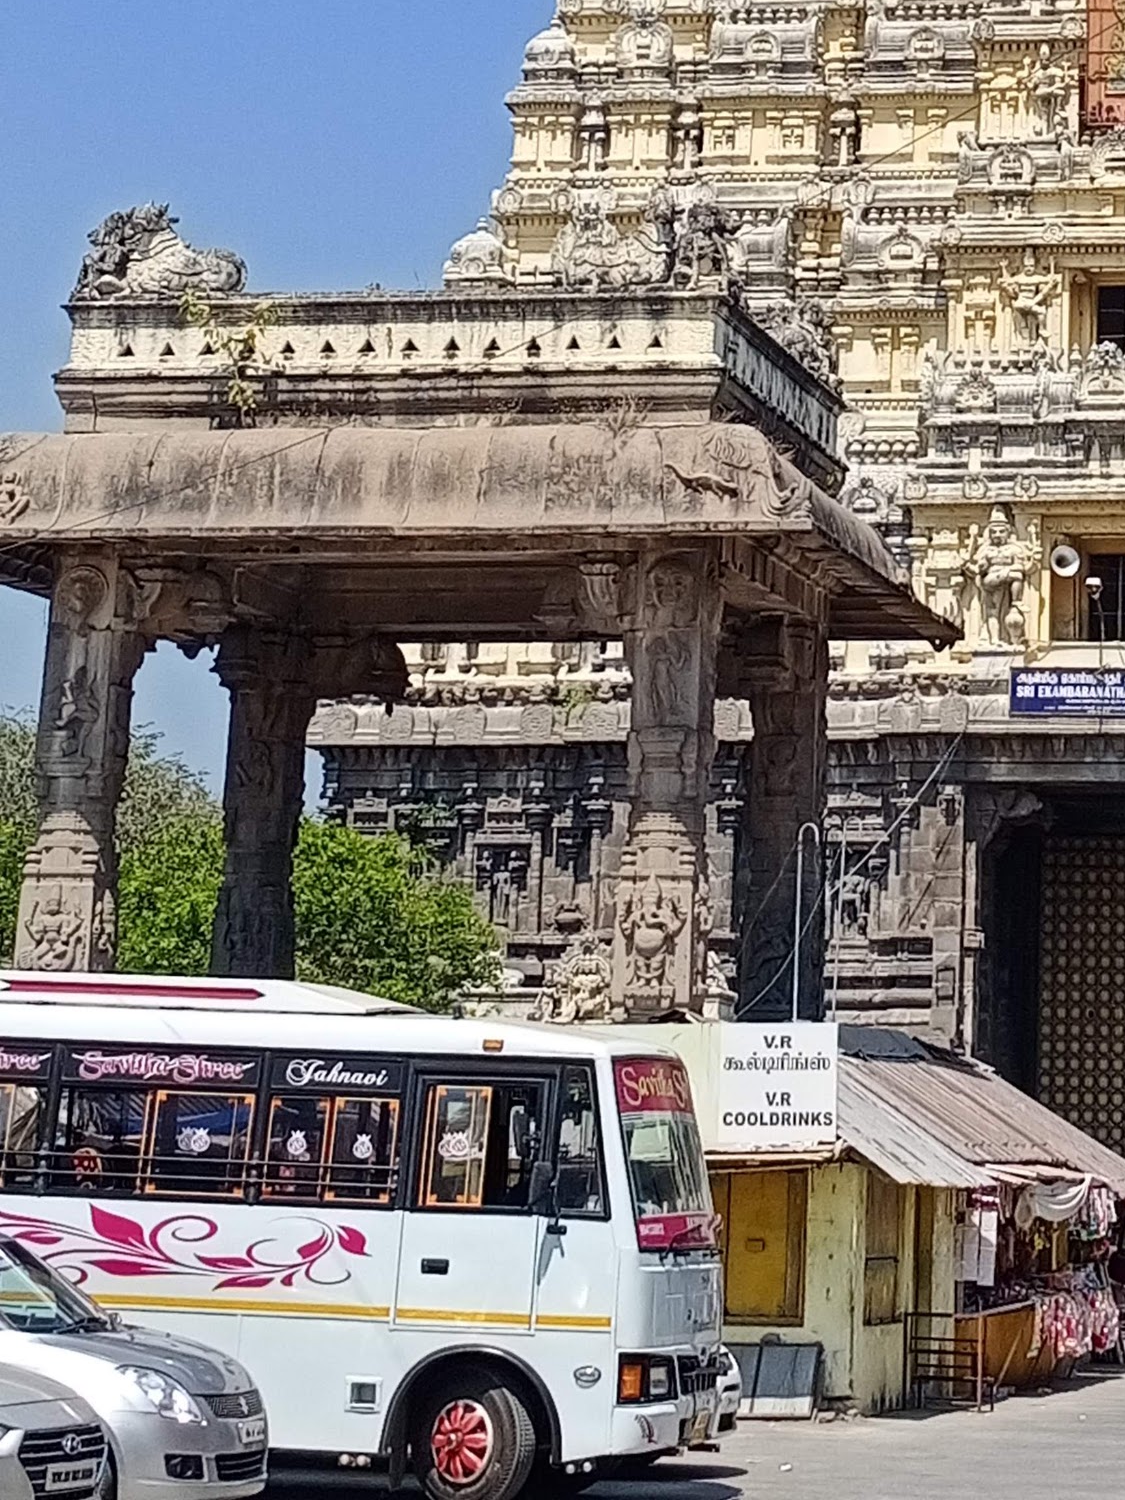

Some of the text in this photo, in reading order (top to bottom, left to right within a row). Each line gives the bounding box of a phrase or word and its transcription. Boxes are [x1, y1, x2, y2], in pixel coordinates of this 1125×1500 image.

[1016, 685, 1035, 698] SRI
[763, 1035, 793, 1049] V.R
[765, 1091, 792, 1107] V.R
[723, 1111, 833, 1126] COOLDRINKS
